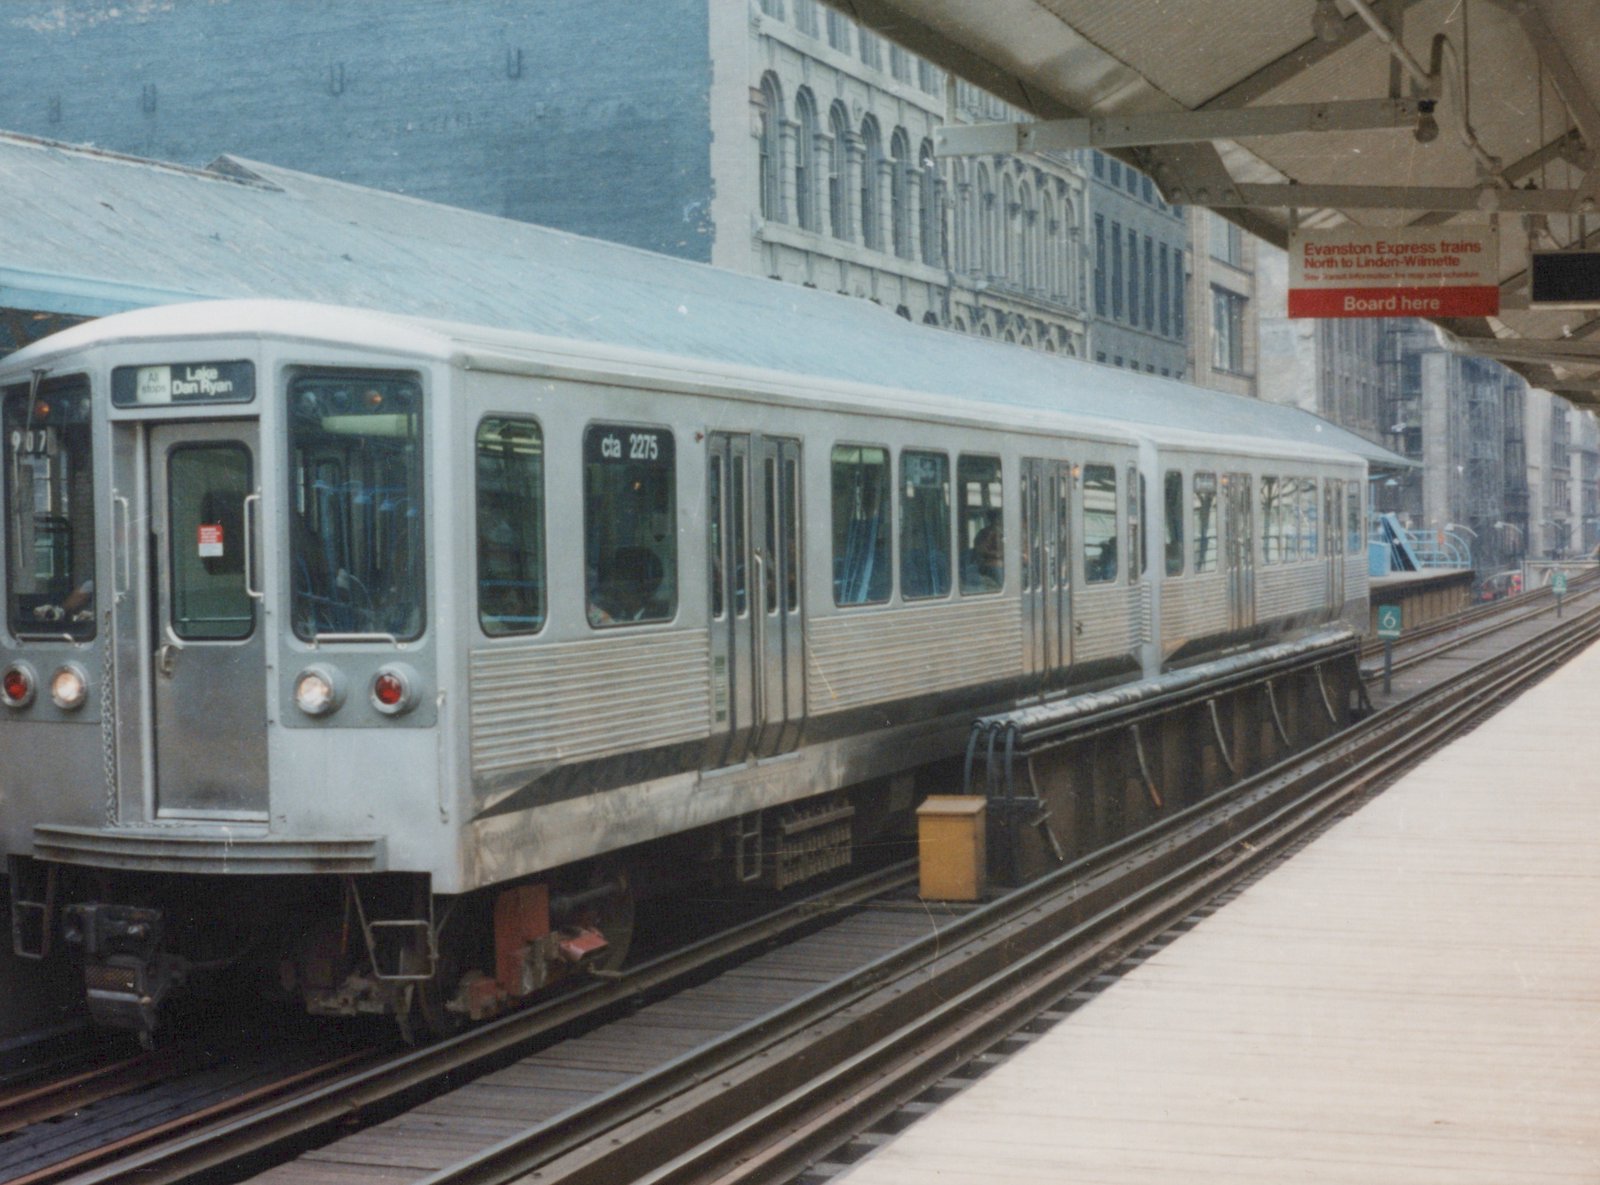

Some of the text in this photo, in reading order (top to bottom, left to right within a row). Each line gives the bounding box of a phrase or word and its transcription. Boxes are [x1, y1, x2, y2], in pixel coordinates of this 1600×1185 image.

[1304, 241, 1481, 256] Evanston Express trains
[1304, 256, 1460, 268] North to Linden-Wilmette
[1344, 295, 1440, 311] Board here
[186, 366, 218, 381] Lake
[172, 378, 233, 396] Dan Ryan
[601, 433, 659, 460] cta 2275
[1383, 611, 1396, 629] 6
